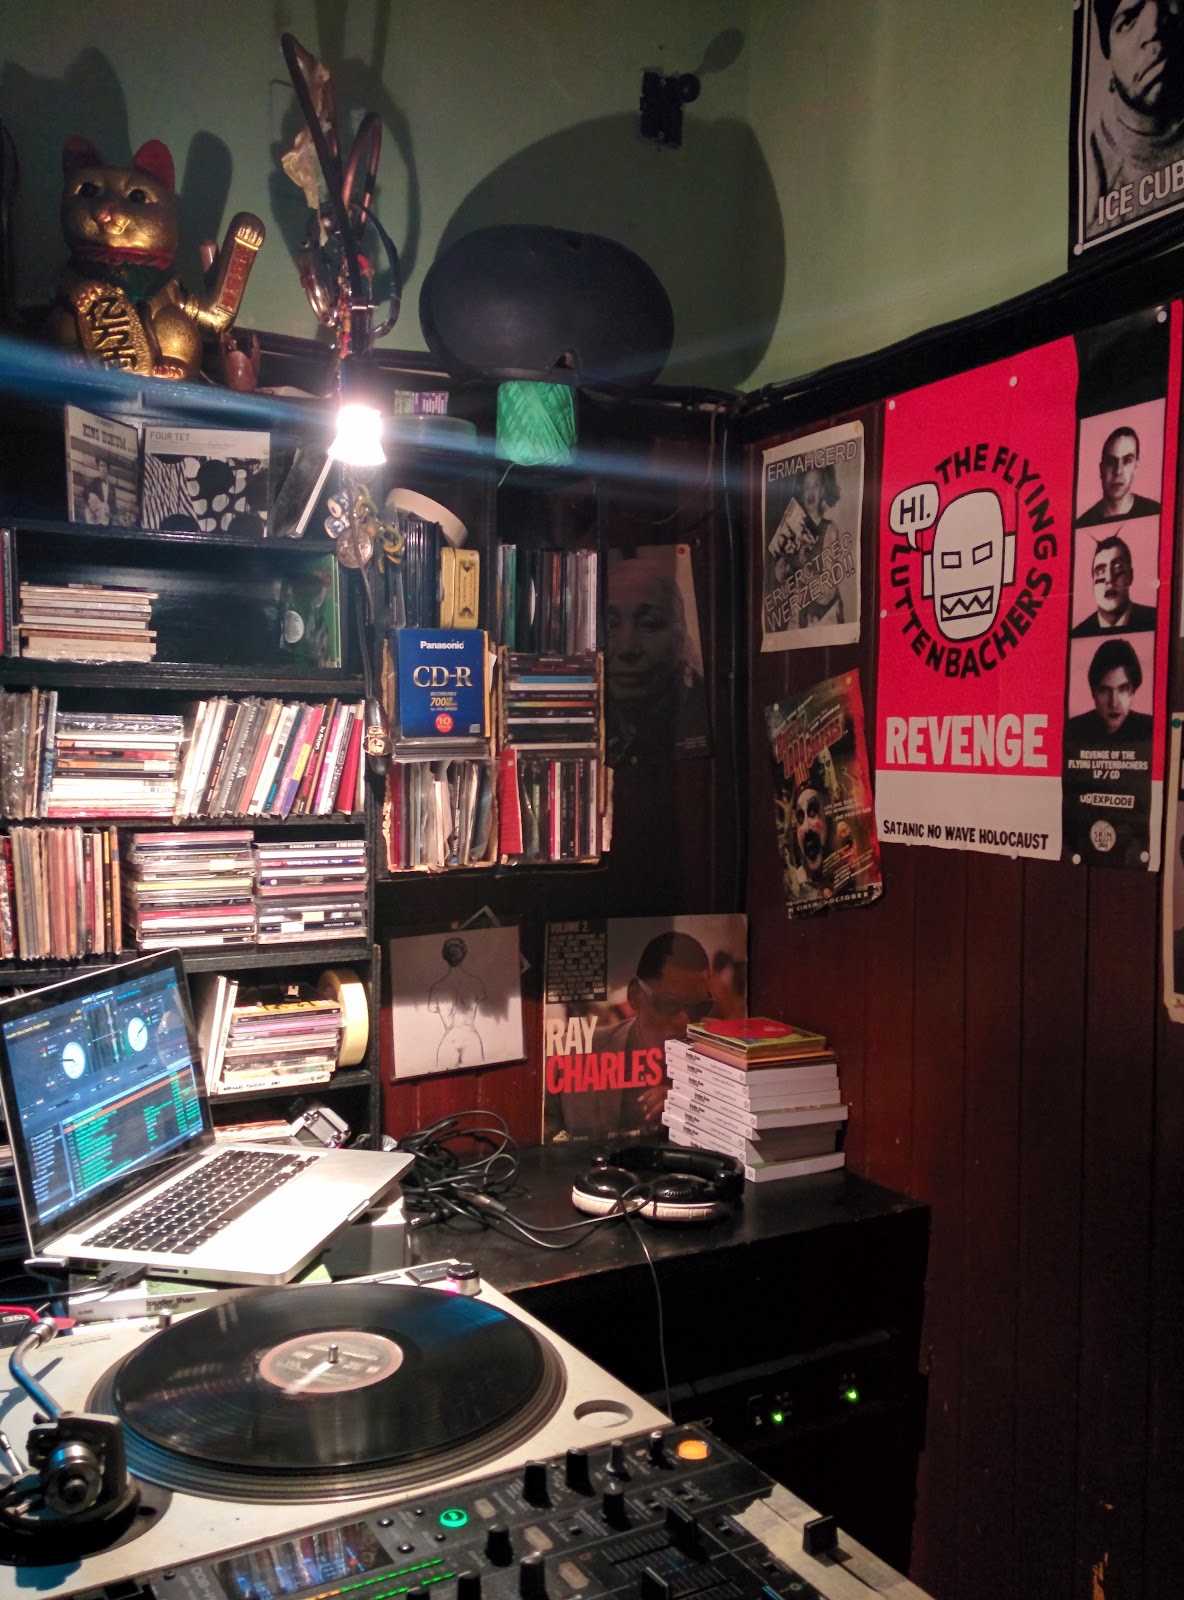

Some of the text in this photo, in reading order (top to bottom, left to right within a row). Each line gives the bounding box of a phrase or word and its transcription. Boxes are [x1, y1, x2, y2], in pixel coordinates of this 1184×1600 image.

[1098, 183, 1133, 226] ICE
[150, 431, 190, 441] FOUR TET
[767, 441, 857, 482] ERMAHGERD
[900, 494, 931, 525] HI.
[890, 443, 1058, 679] THE FLYING LUTTENBACHERS
[764, 533, 852, 612] ERLERCTREC
[766, 552, 856, 631] WERZERD!!
[420, 640, 464, 649] Panasonic
[413, 666, 472, 687] CD-R
[430, 697, 447, 706] 700
[439, 717, 451, 725] 10
[886, 714, 1048, 768] REVENGE
[1068, 760, 1148, 770] FLYING LUTTENBACHERS
[1080, 750, 1135, 760] REVENGE OF THE
[1093, 770, 1103, 779] LP
[1110, 771, 1120, 779] CD
[1093, 795, 1133, 807] EXPLODE
[883, 820, 1049, 850] SATANIC NO WAVE HOLOCAUST
[796, 901, 818, 911] CINEM
[829, 891, 869, 904] OCTOBER
[547, 1015, 598, 1056] RAY
[546, 1047, 663, 1095] CHARLES
[146, 1299, 174, 1307] louder
